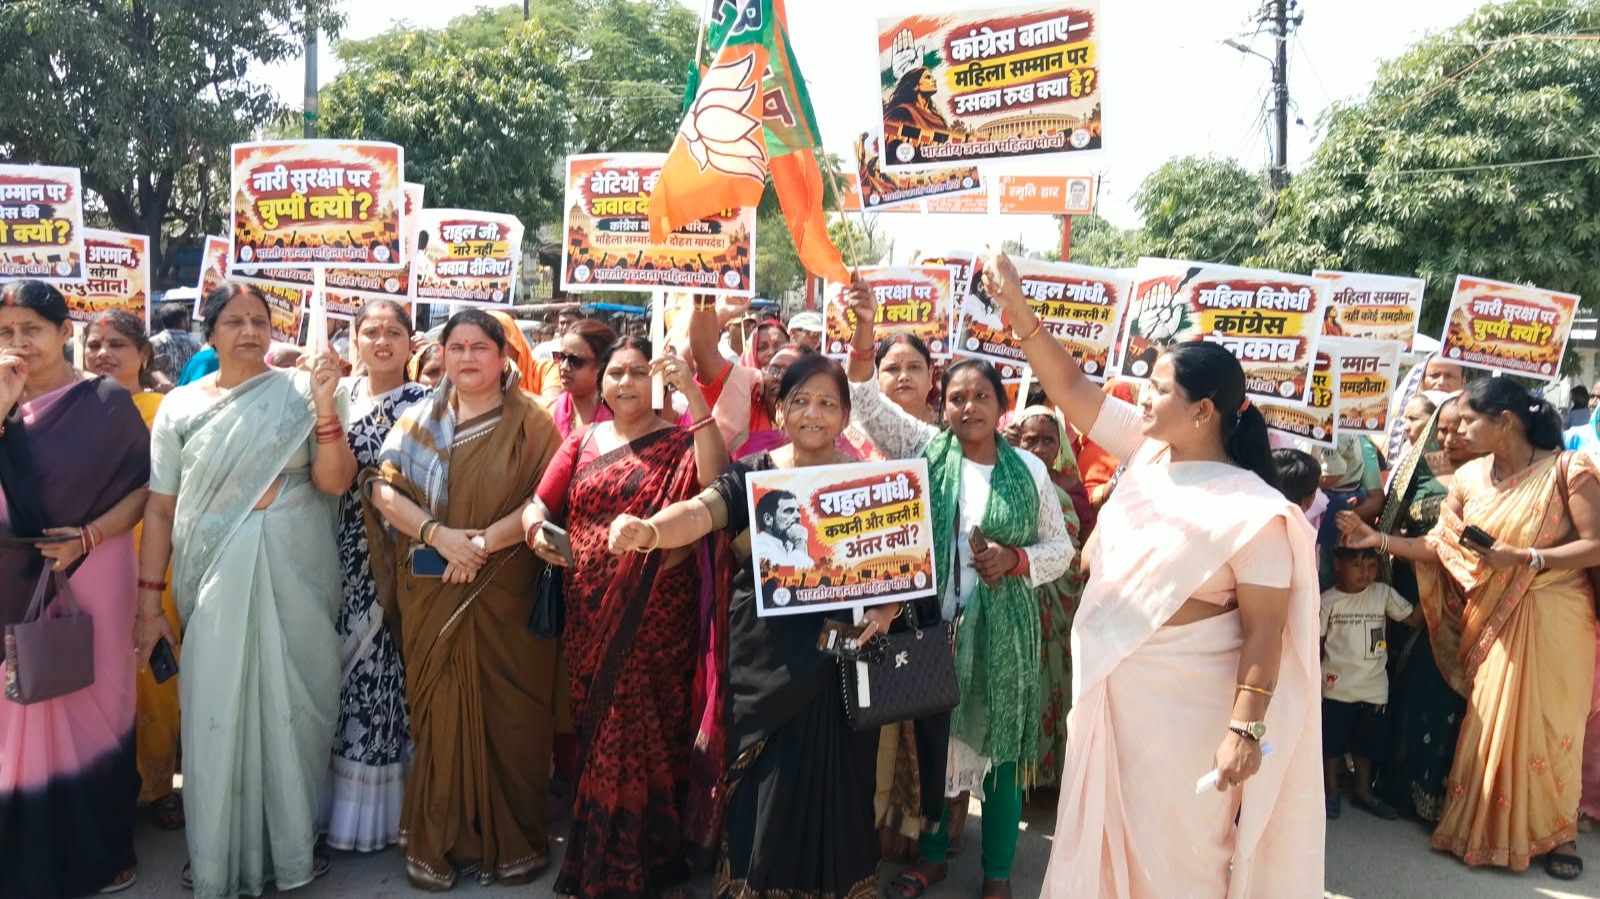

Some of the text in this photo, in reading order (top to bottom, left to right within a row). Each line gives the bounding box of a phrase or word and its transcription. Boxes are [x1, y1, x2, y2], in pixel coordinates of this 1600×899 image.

[950, 27, 1016, 61] कांग्रेस
[954, 46, 1089, 87] महिला सम्मान पर
[954, 68, 1095, 114] उसका रुख क्या है?
[921, 132, 1065, 158] भारतीय जनता महिला मोर्चा
[46, 184, 67, 200] पर
[253, 165, 372, 194] नारी सुरक्षा पर
[591, 170, 640, 195] बेटियों
[21, 204, 40, 219] की
[257, 188, 373, 229] चुप्पी क्यों?
[591, 191, 650, 217] जवाबदे
[12, 219, 71, 244] क्यों?
[442, 222, 501, 243] राहुल जी,
[610, 218, 639, 232] कांग्रेस
[454, 242, 470, 256] नारे
[595, 232, 622, 246] महिला
[89, 247, 136, 267] अपमान,
[437, 258, 511, 276] जवाब दीजिए!
[89, 266, 118, 279] सहेगा
[594, 266, 719, 284] भारतीय जनता महिला मोर्चा
[914, 285, 933, 299] पर
[1021, 279, 1109, 305] राहुल गांधी,
[1198, 284, 1311, 311] महिला विरोधी
[1333, 287, 1371, 304] महिला
[886, 298, 932, 322] क्यों?
[1051, 304, 1070, 317] और
[1072, 307, 1099, 319] करनी
[1099, 308, 1111, 320] में
[1214, 310, 1287, 335] कांग्रेस
[1344, 310, 1359, 321] नहीं
[1361, 309, 1378, 323] कोई
[1473, 298, 1503, 317] नारी
[1503, 303, 1540, 323] सुरक्षा
[1541, 310, 1557, 325] पर
[1066, 321, 1104, 340] क्यों?
[1473, 319, 1552, 346] चुप्पी क्यों?
[1313, 375, 1327, 386] पर
[819, 473, 915, 518] राहुल गांधी,
[825, 502, 920, 537] कथनी और करनी में
[845, 524, 920, 559] अंतर क्यों?
[796, 576, 911, 601] भारतीय जनता महिला मोर्चा
